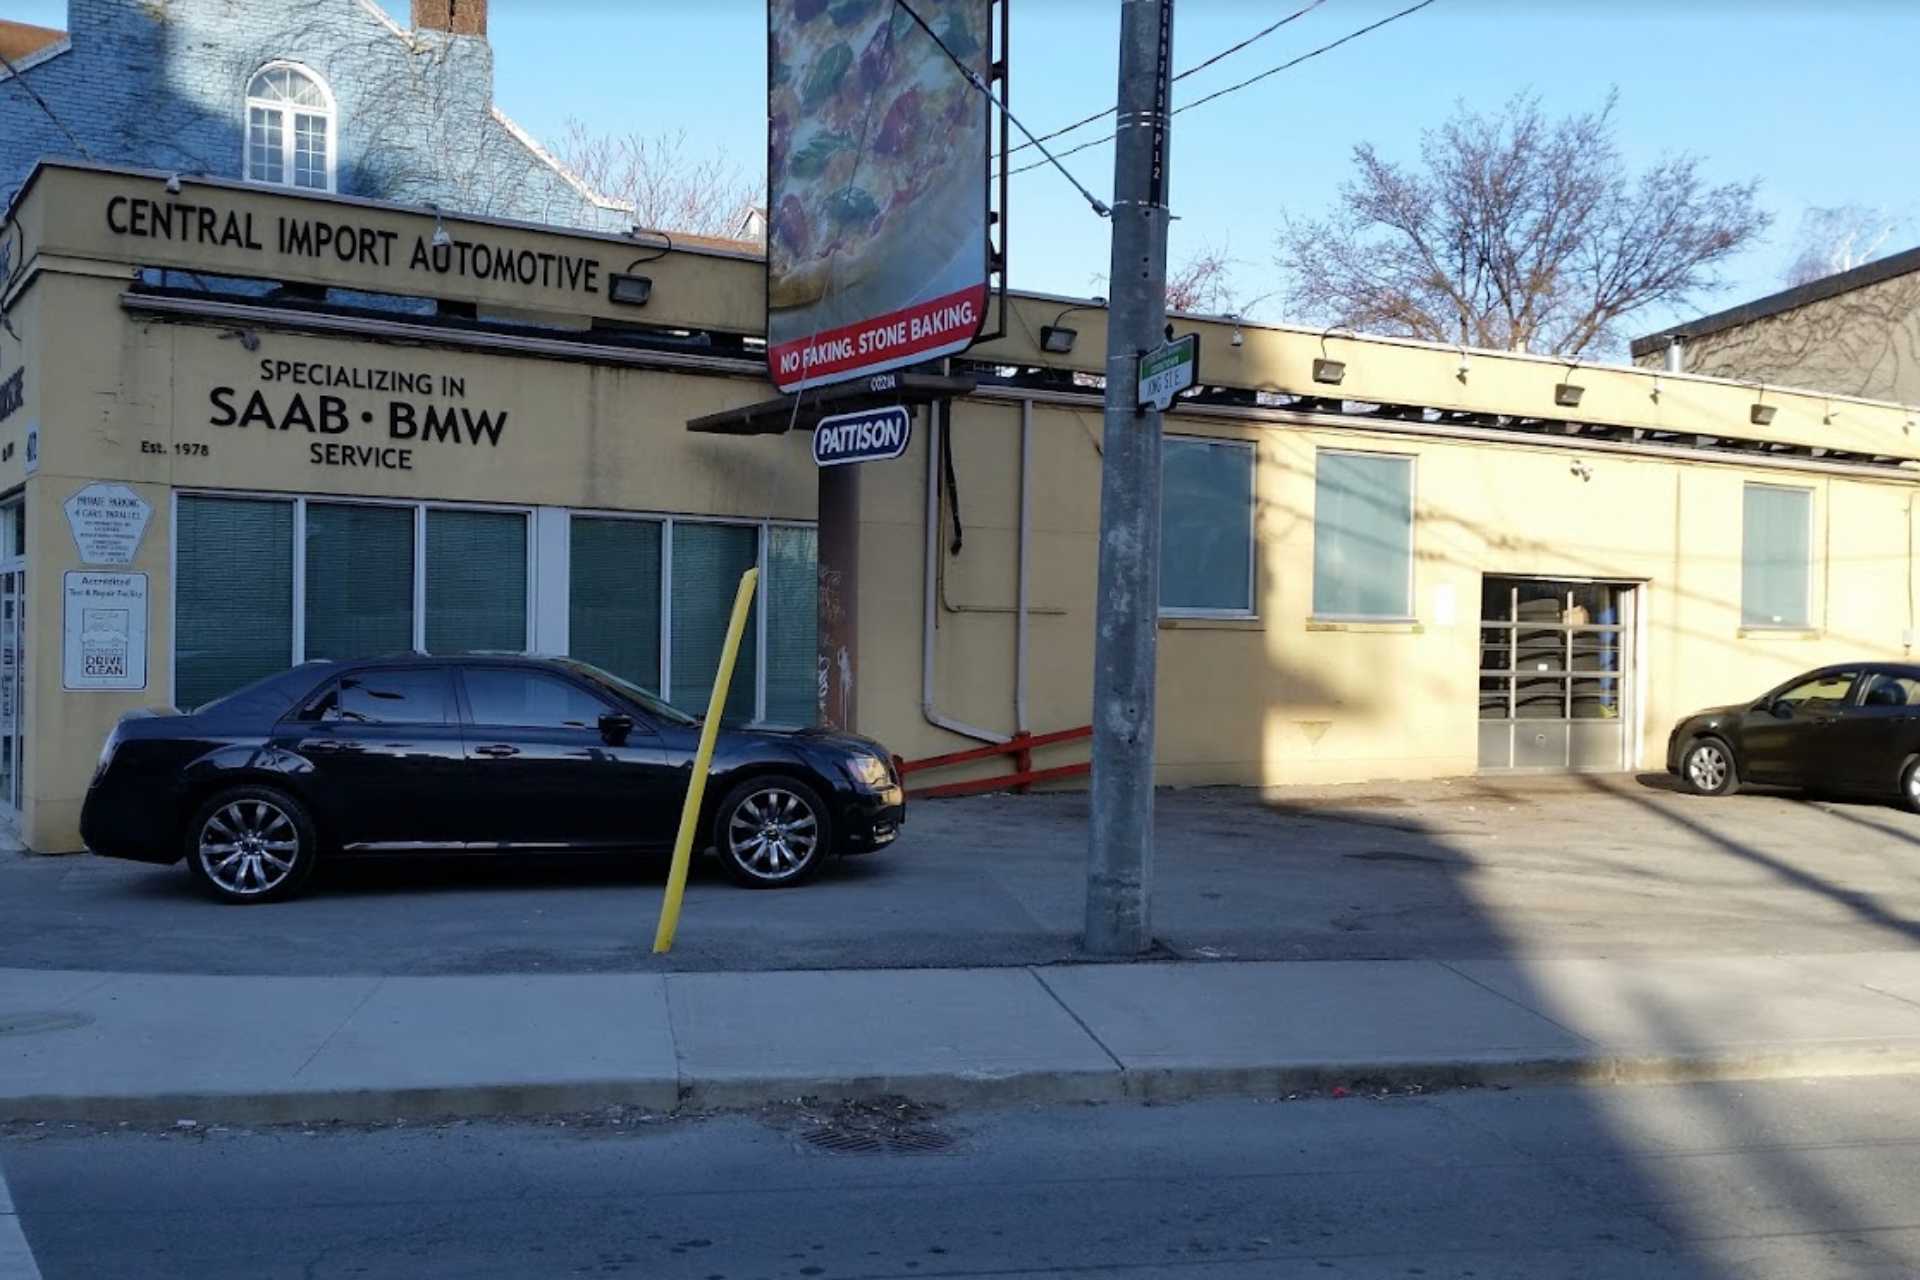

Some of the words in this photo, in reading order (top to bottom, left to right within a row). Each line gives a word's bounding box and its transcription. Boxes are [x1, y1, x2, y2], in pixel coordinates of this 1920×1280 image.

[107, 197, 262, 251] CENTRAL
[279, 217, 399, 266] IMPORT
[409, 237, 600, 293] AUTOMOTIVE
[781, 349, 799, 374] NO
[802, 337, 855, 369] FAKING.
[859, 322, 906, 354] STONE
[911, 301, 976, 339] BAKING.
[260, 358, 433, 396] SPECIALIZING
[442, 376, 465, 397] IN
[209, 386, 349, 435] SAAB
[389, 402, 508, 448] BMW
[141, 441, 167, 455] Est.
[174, 442, 209, 457] 1978
[819, 418, 901, 454] PATTISON
[310, 442, 412, 470] SERVICE
[85, 655, 123, 665] DRIVE
[85, 665, 123, 675] CLEAN
